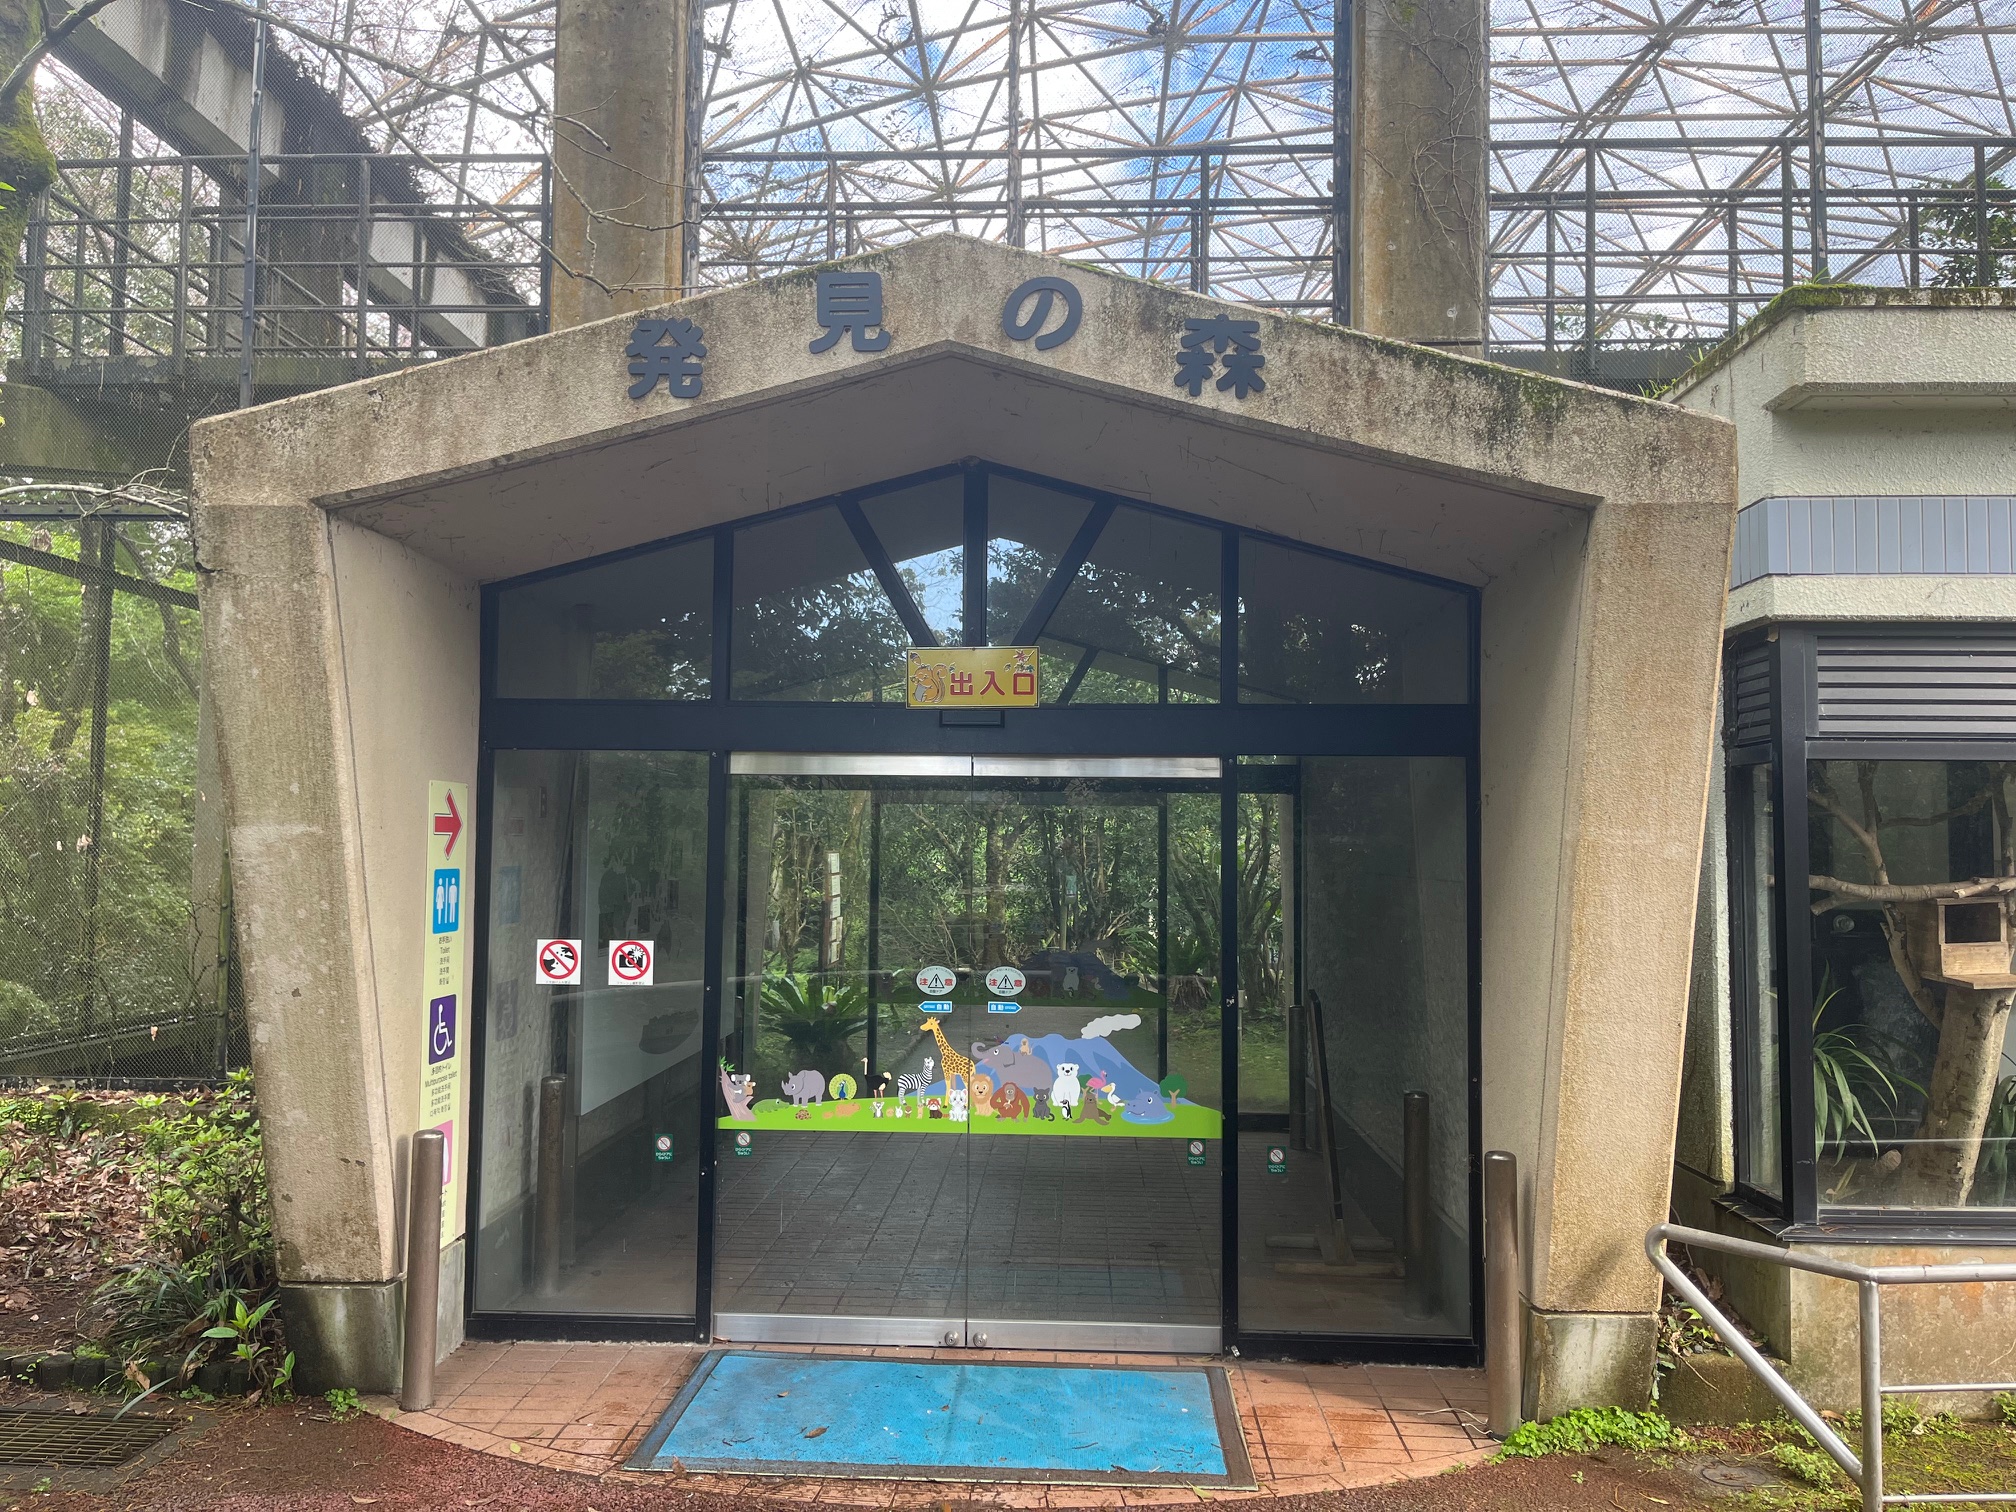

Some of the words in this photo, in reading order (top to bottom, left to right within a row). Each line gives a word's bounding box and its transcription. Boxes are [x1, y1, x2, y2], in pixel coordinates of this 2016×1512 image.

[625, 271, 1266, 400] 発見の森
[949, 670, 1035, 696] 出入口
